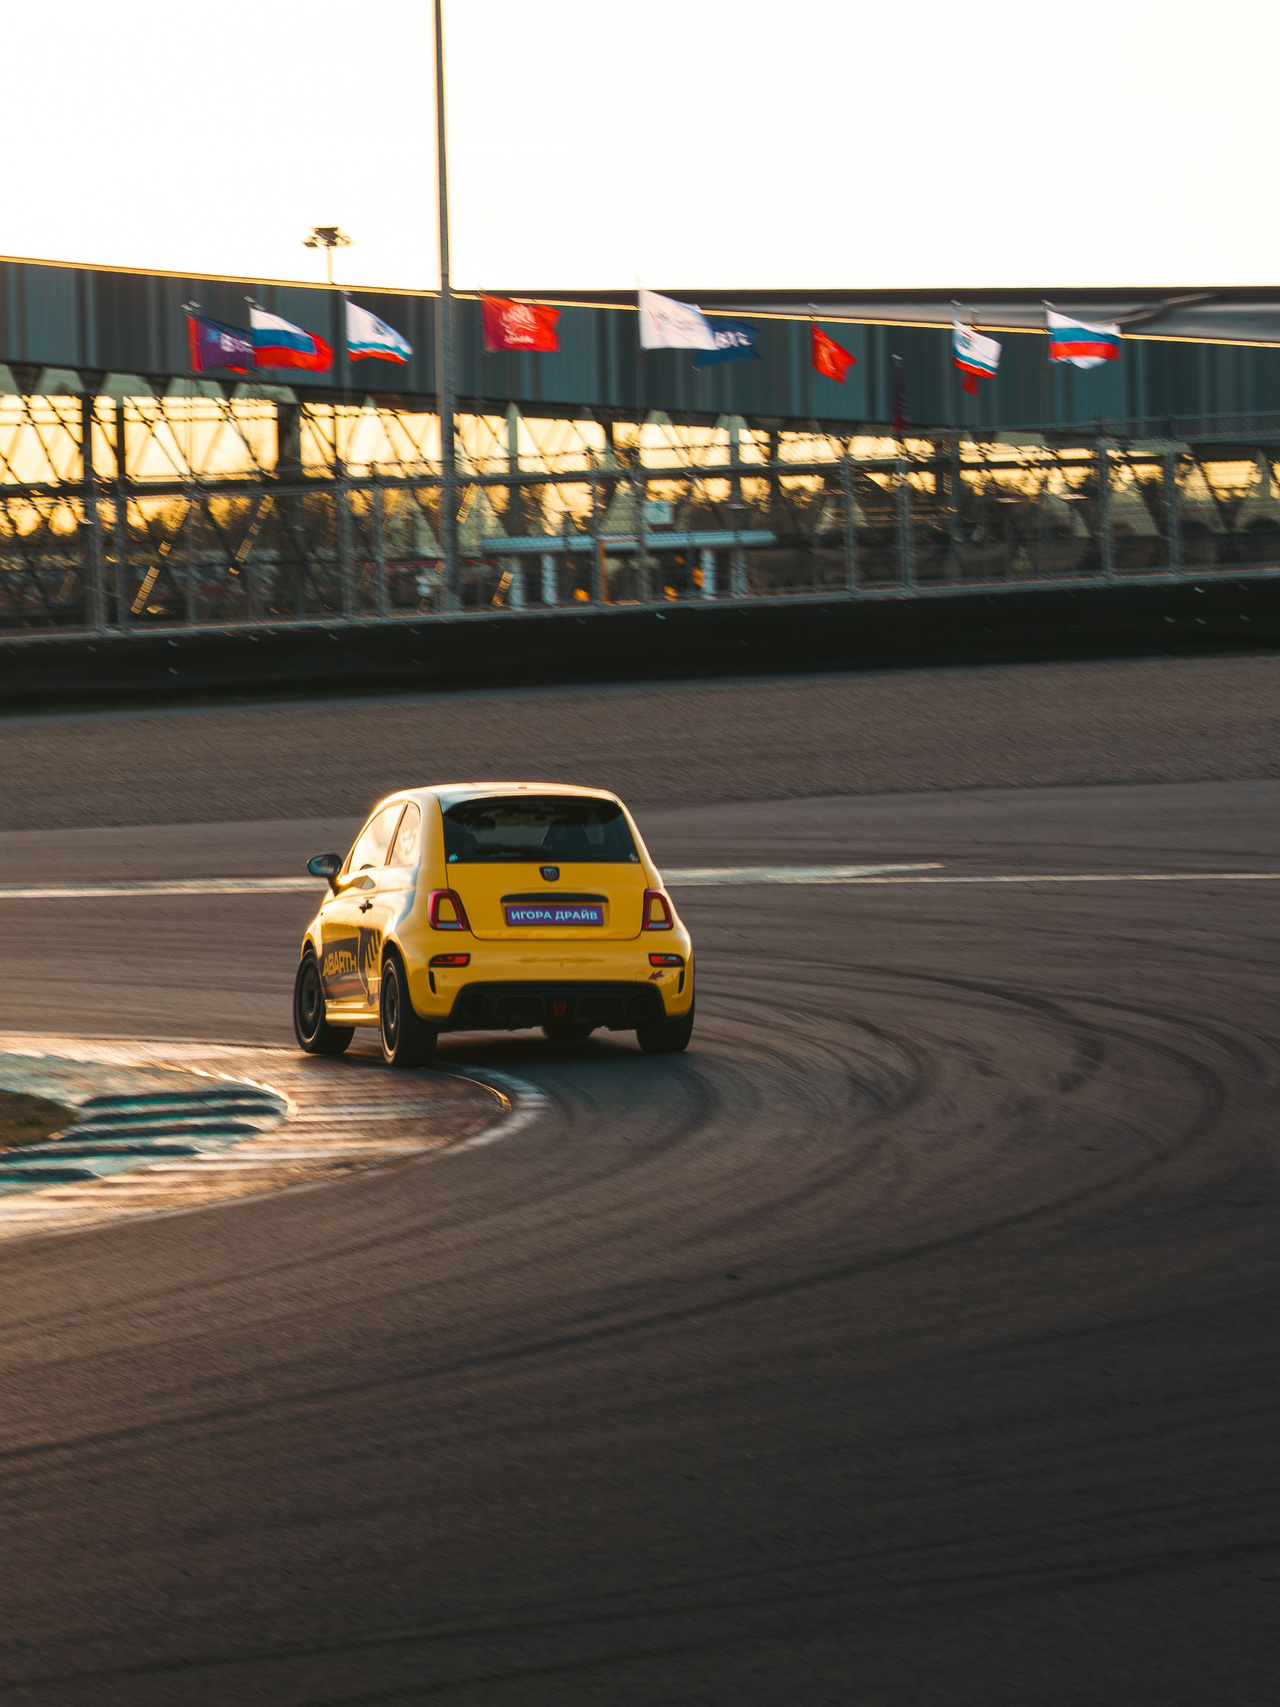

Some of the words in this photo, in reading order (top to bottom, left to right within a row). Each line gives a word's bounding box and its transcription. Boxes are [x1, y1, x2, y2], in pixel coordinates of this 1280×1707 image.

[511, 910, 552, 920] ИГОРА
[555, 908, 598, 921] ДРАЙВ
[322, 950, 358, 977] ABARTH
